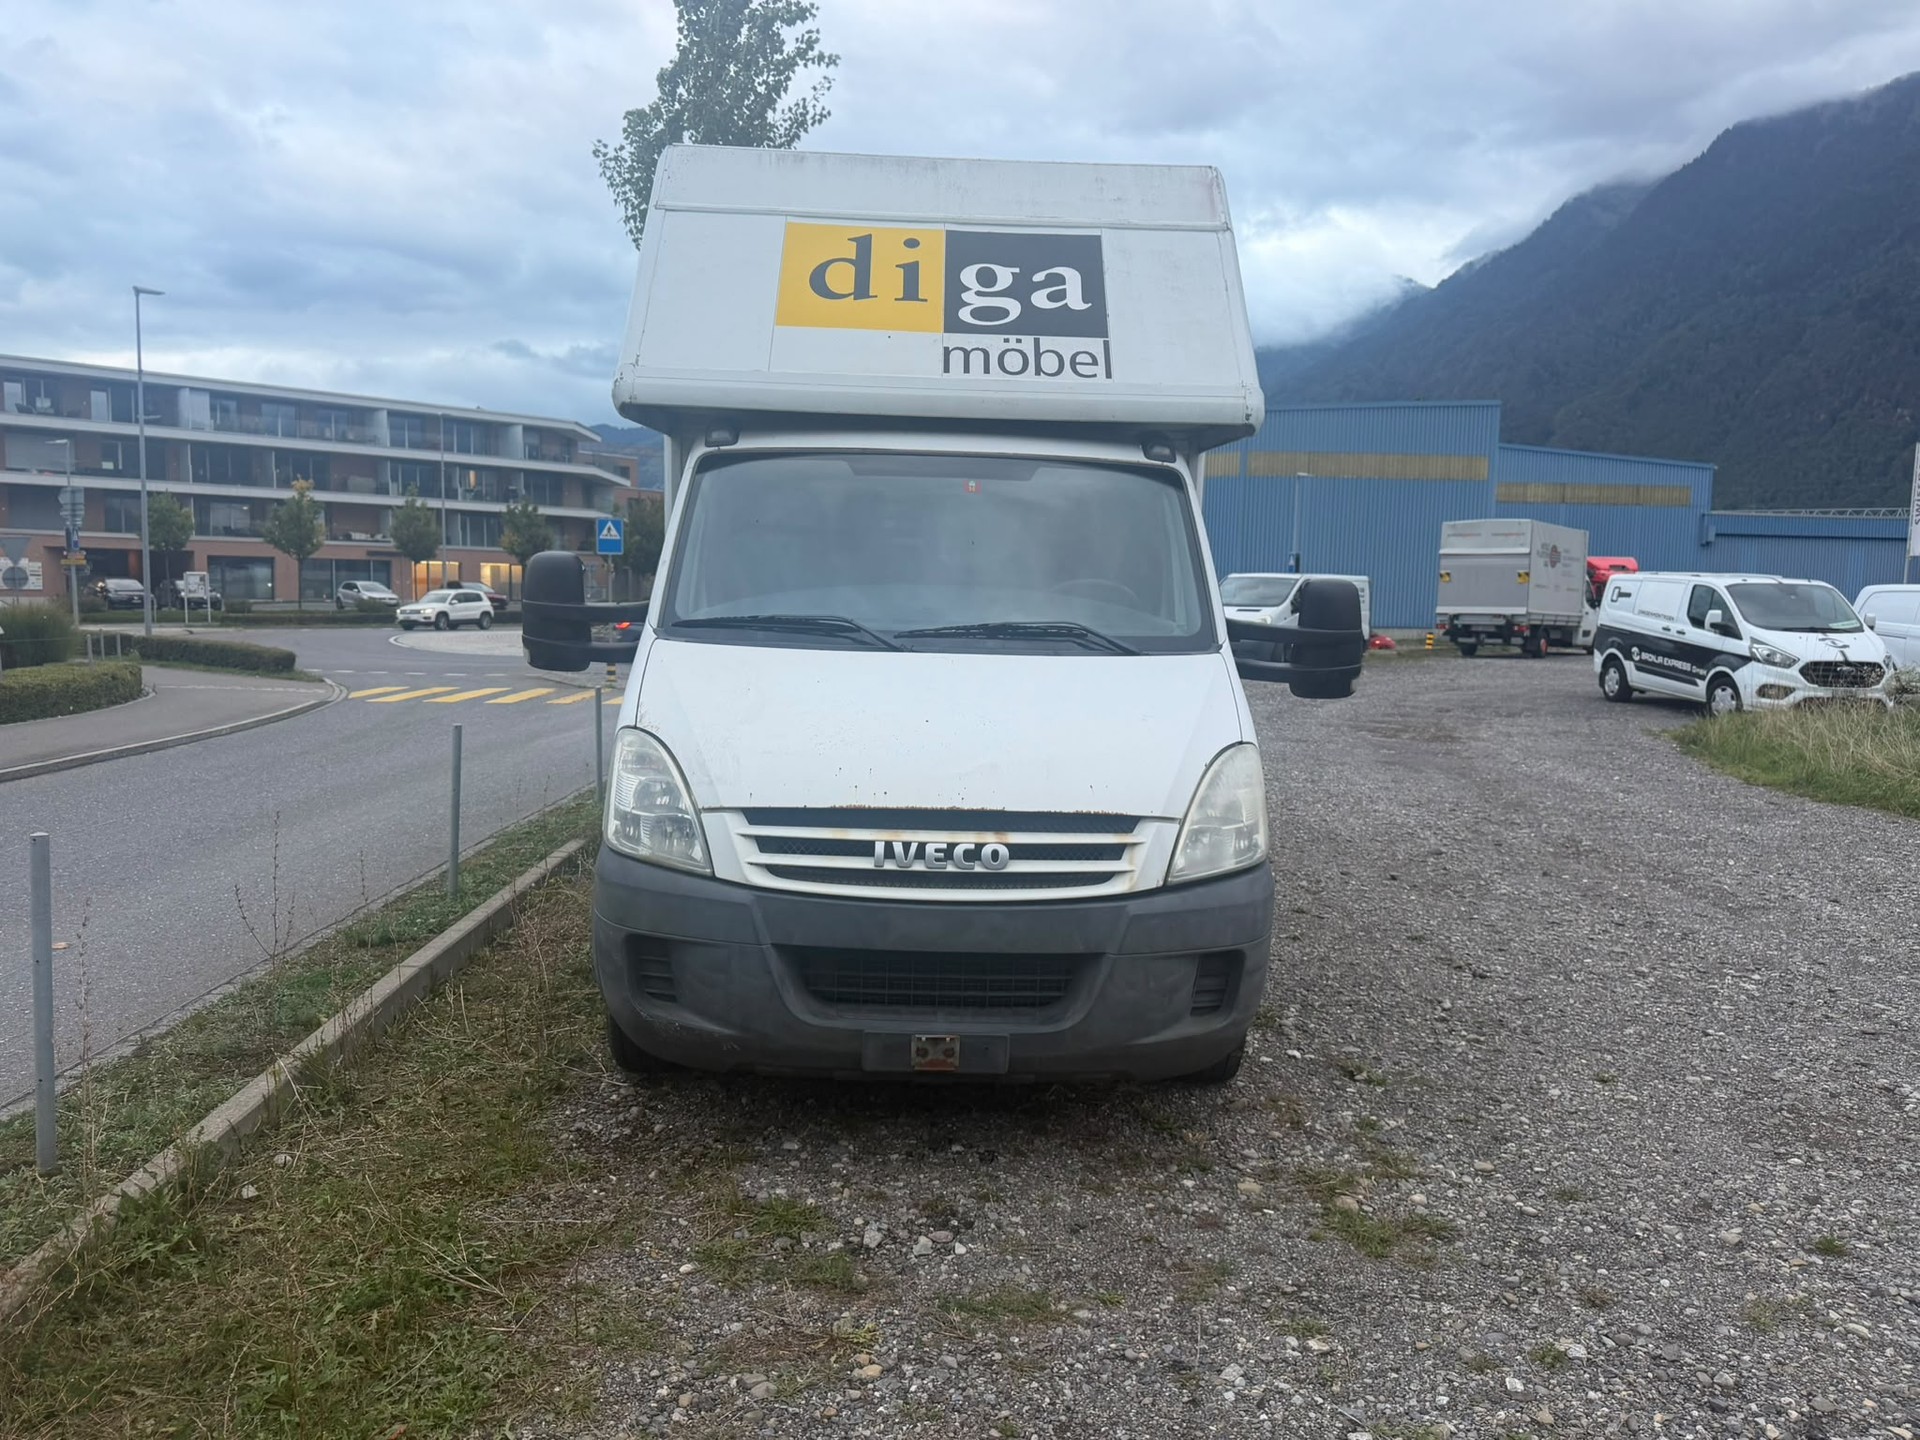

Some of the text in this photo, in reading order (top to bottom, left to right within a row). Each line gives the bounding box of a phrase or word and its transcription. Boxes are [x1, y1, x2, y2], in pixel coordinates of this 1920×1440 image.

[808, 233, 1093, 326] diga
[942, 337, 1113, 380] möbel
[1663, 657, 1692, 672] EXPRESS
[873, 840, 1010, 870] IVECO
